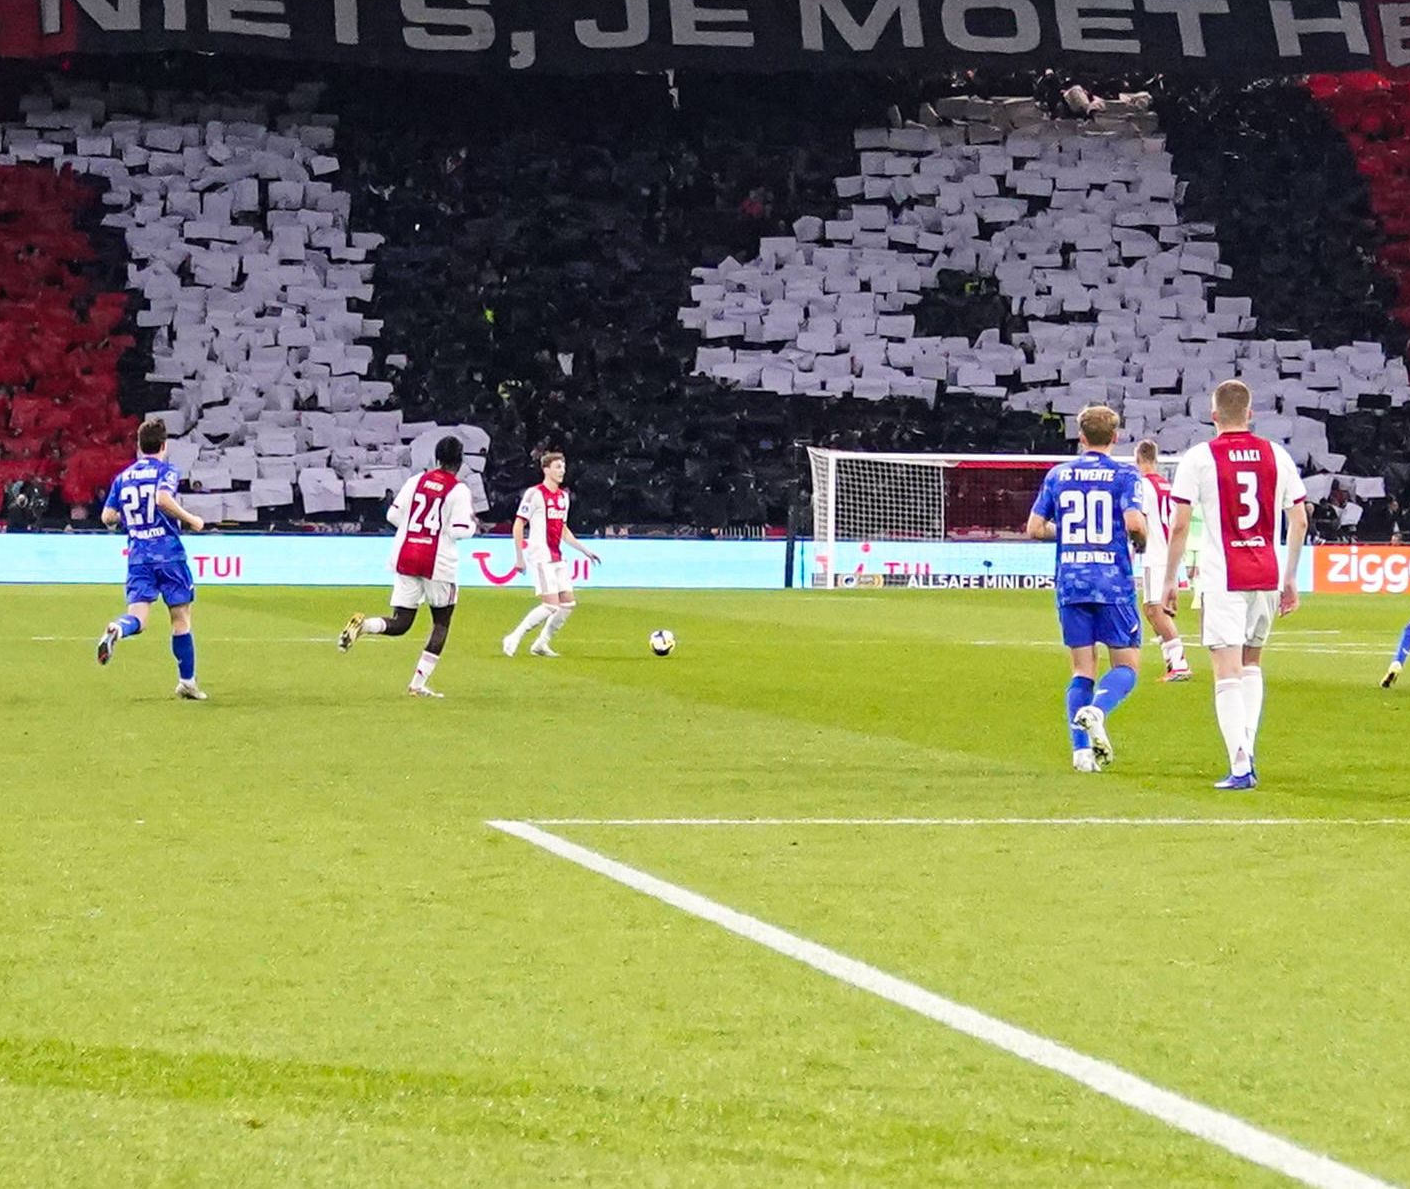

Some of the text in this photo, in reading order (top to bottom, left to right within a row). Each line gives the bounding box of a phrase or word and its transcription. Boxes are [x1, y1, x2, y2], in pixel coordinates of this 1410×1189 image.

[1059, 468, 1116, 482] FC TWENTE
[120, 483, 156, 526] 27
[408, 492, 443, 536] 24
[1059, 490, 1114, 545] 20
[1236, 471, 1260, 530] 3
[194, 556, 242, 578] TUI
[907, 574, 985, 589] ALLSAFE
[986, 574, 1020, 589] MINI
